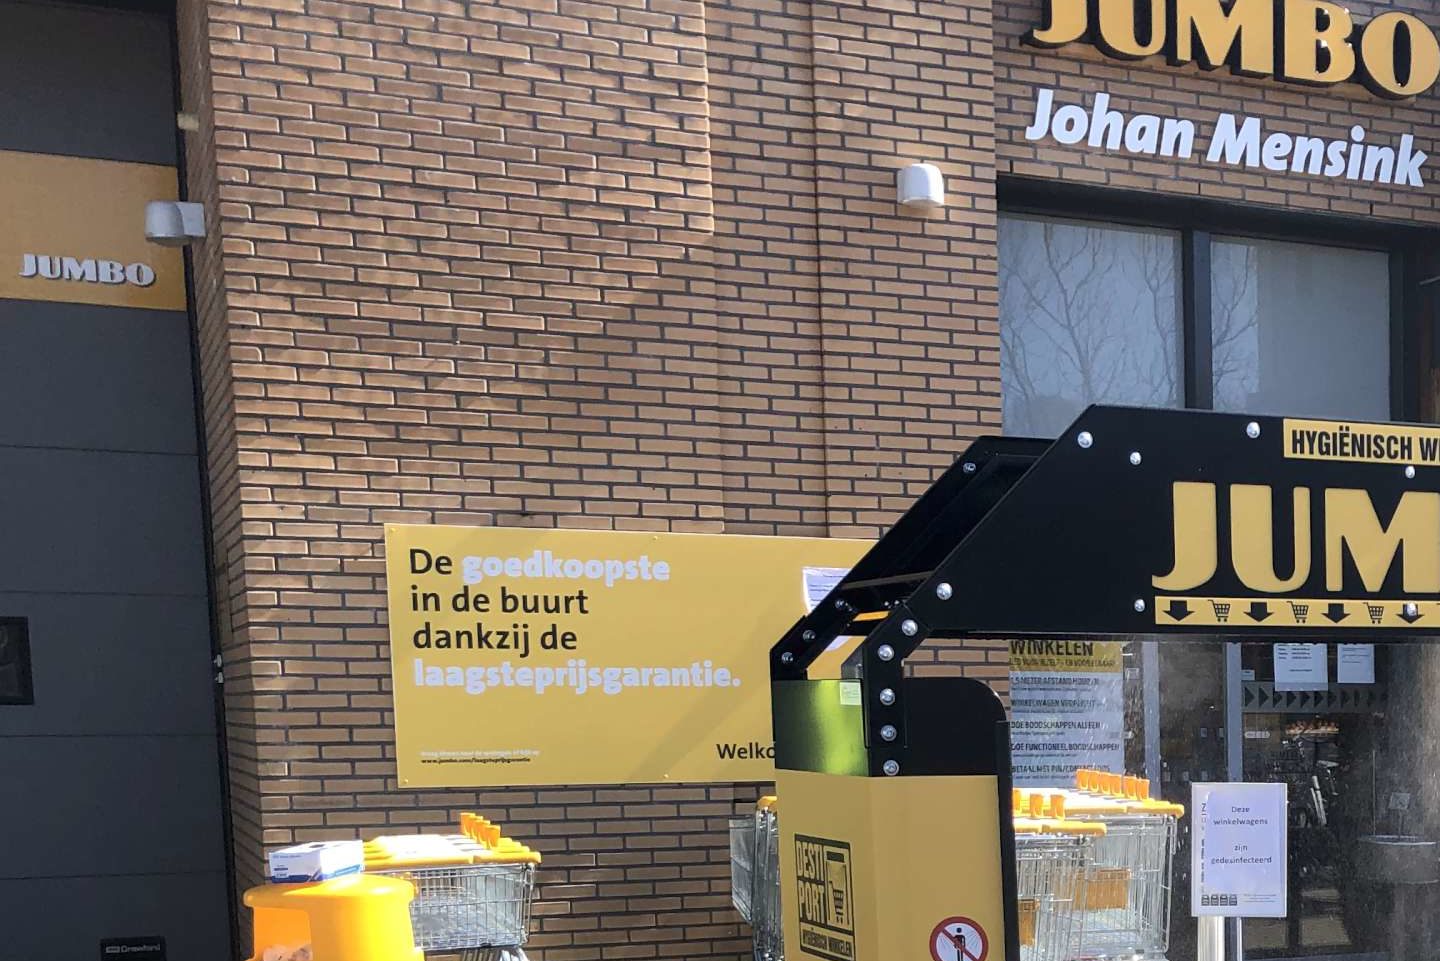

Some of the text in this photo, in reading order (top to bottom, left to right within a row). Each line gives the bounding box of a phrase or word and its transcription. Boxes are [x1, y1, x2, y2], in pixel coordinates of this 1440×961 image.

[1033, 0, 1440, 95] JUMBO
[1025, 88, 1428, 188] Johan Mensink
[18, 252, 156, 287] JUMBO
[1291, 425, 1413, 461] HYGIËNISCH
[408, 548, 671, 588] De goedkoopste
[410, 585, 589, 615] in de buurt
[412, 621, 578, 658] dankzij de
[1010, 640, 1094, 656] WINKELEN
[413, 657, 742, 695] laagsteprijsgarantie.
[716, 742, 776, 760] Welko
[1213, 818, 1268, 826] winkelwagens
[796, 840, 824, 882] DESTI
[1234, 844, 1248, 852] zijn
[798, 880, 826, 924] PORT
